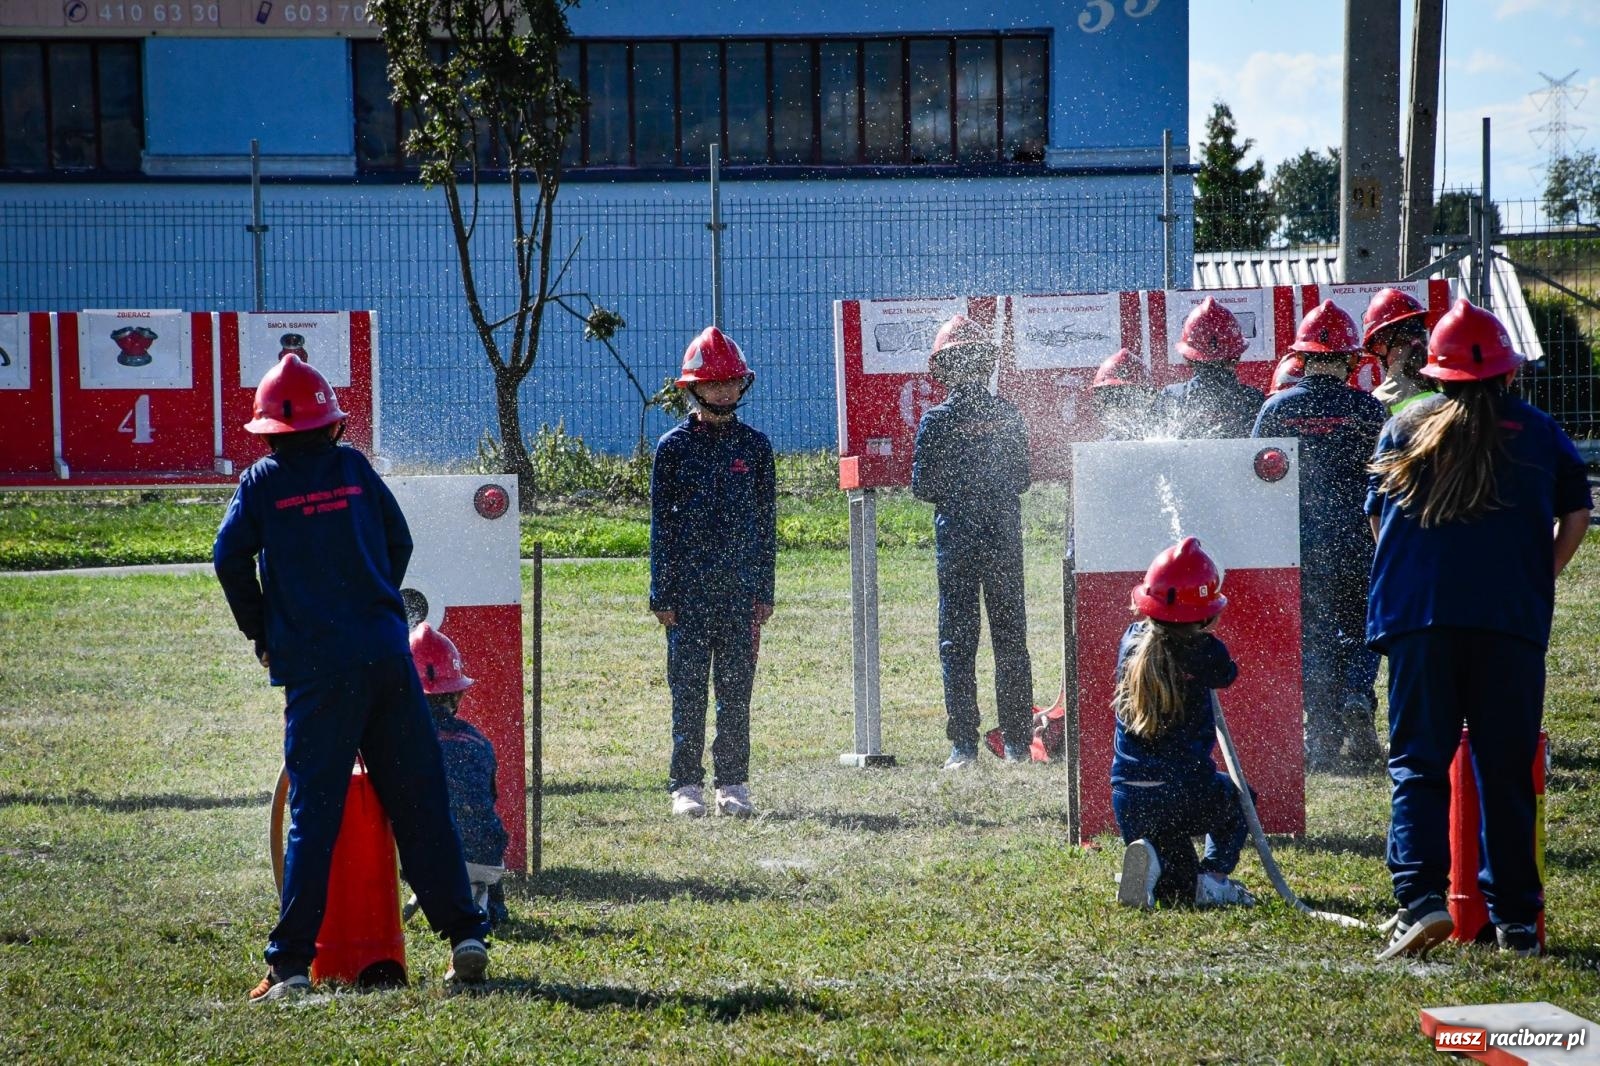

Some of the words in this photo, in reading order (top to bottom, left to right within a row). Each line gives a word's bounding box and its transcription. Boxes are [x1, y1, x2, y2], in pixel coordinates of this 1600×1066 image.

[100, 4, 143, 22] 410
[153, 4, 182, 22] 63
[191, 4, 219, 22] 30
[284, 4, 328, 22] 603
[116, 311, 151, 319] ZBIERACZ
[117, 394, 157, 444] 4
